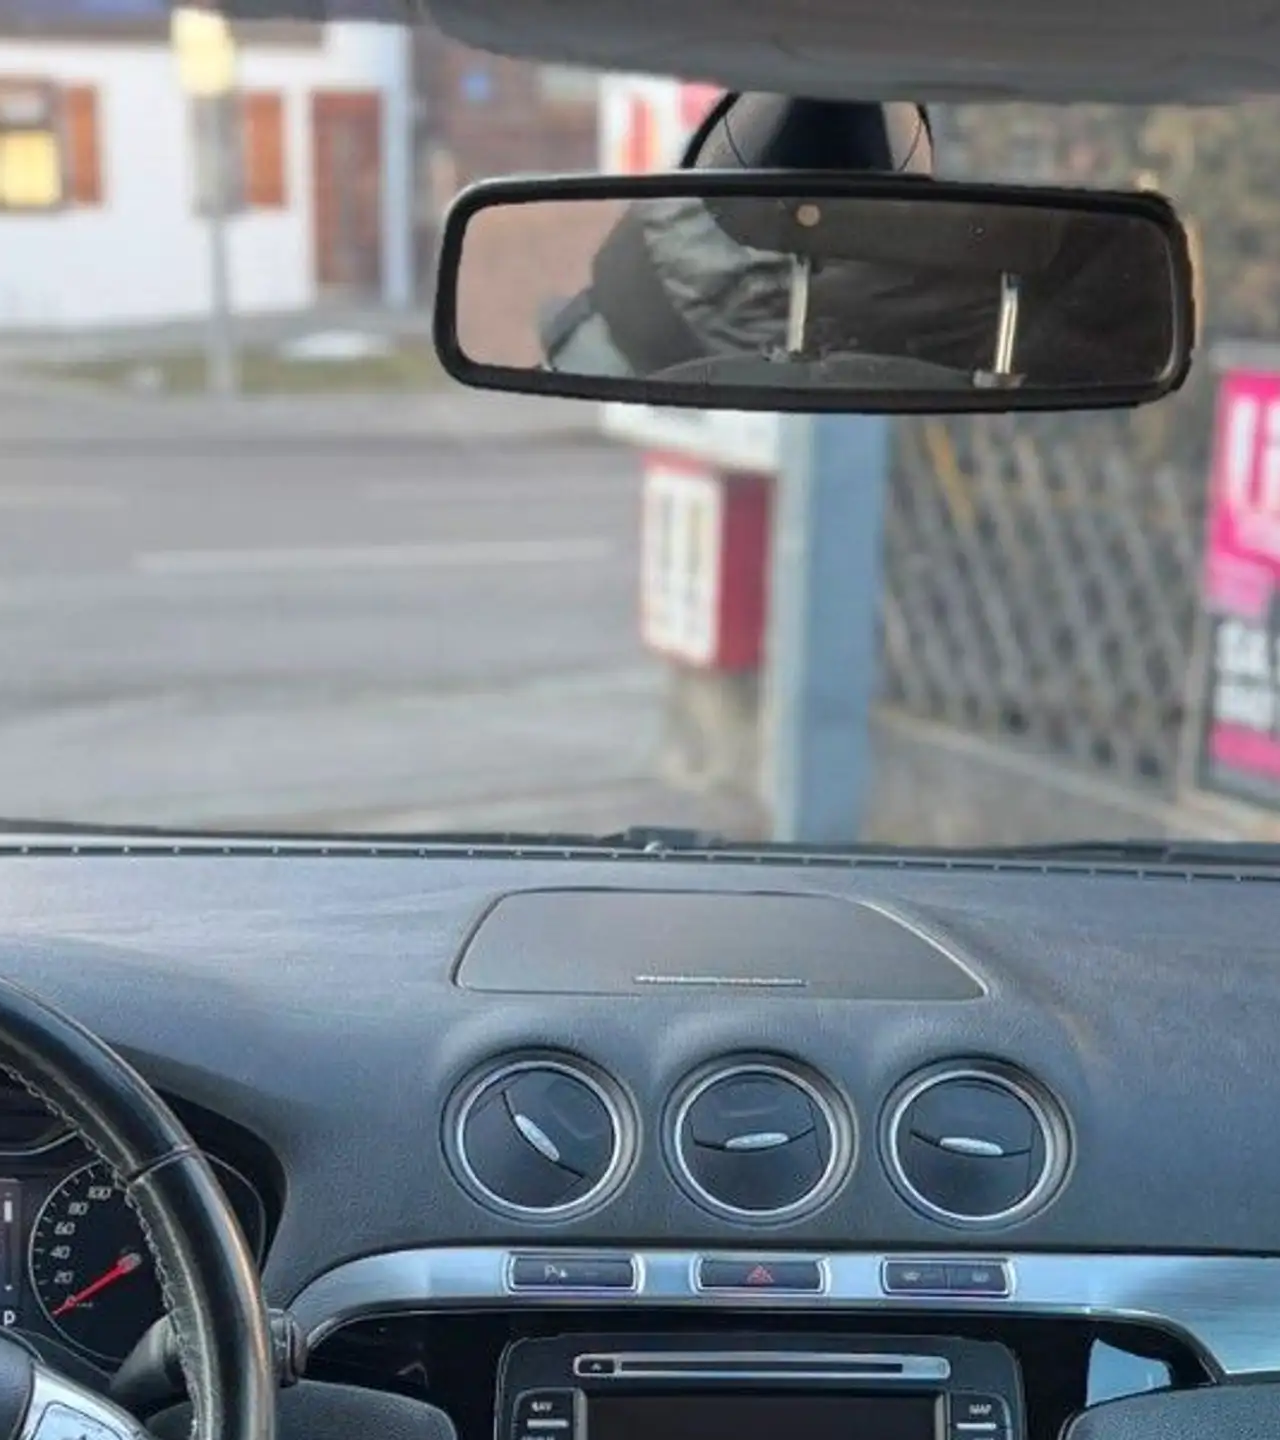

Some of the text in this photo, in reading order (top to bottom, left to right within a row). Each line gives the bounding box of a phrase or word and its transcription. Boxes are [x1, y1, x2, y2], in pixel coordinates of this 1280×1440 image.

[88, 1186, 112, 1200] 100
[68, 1202, 88, 1215] 80
[54, 1222, 75, 1235] 60
[50, 1245, 70, 1259] 40
[54, 1271, 74, 1284] 20
[3, 1310, 16, 1326] P
